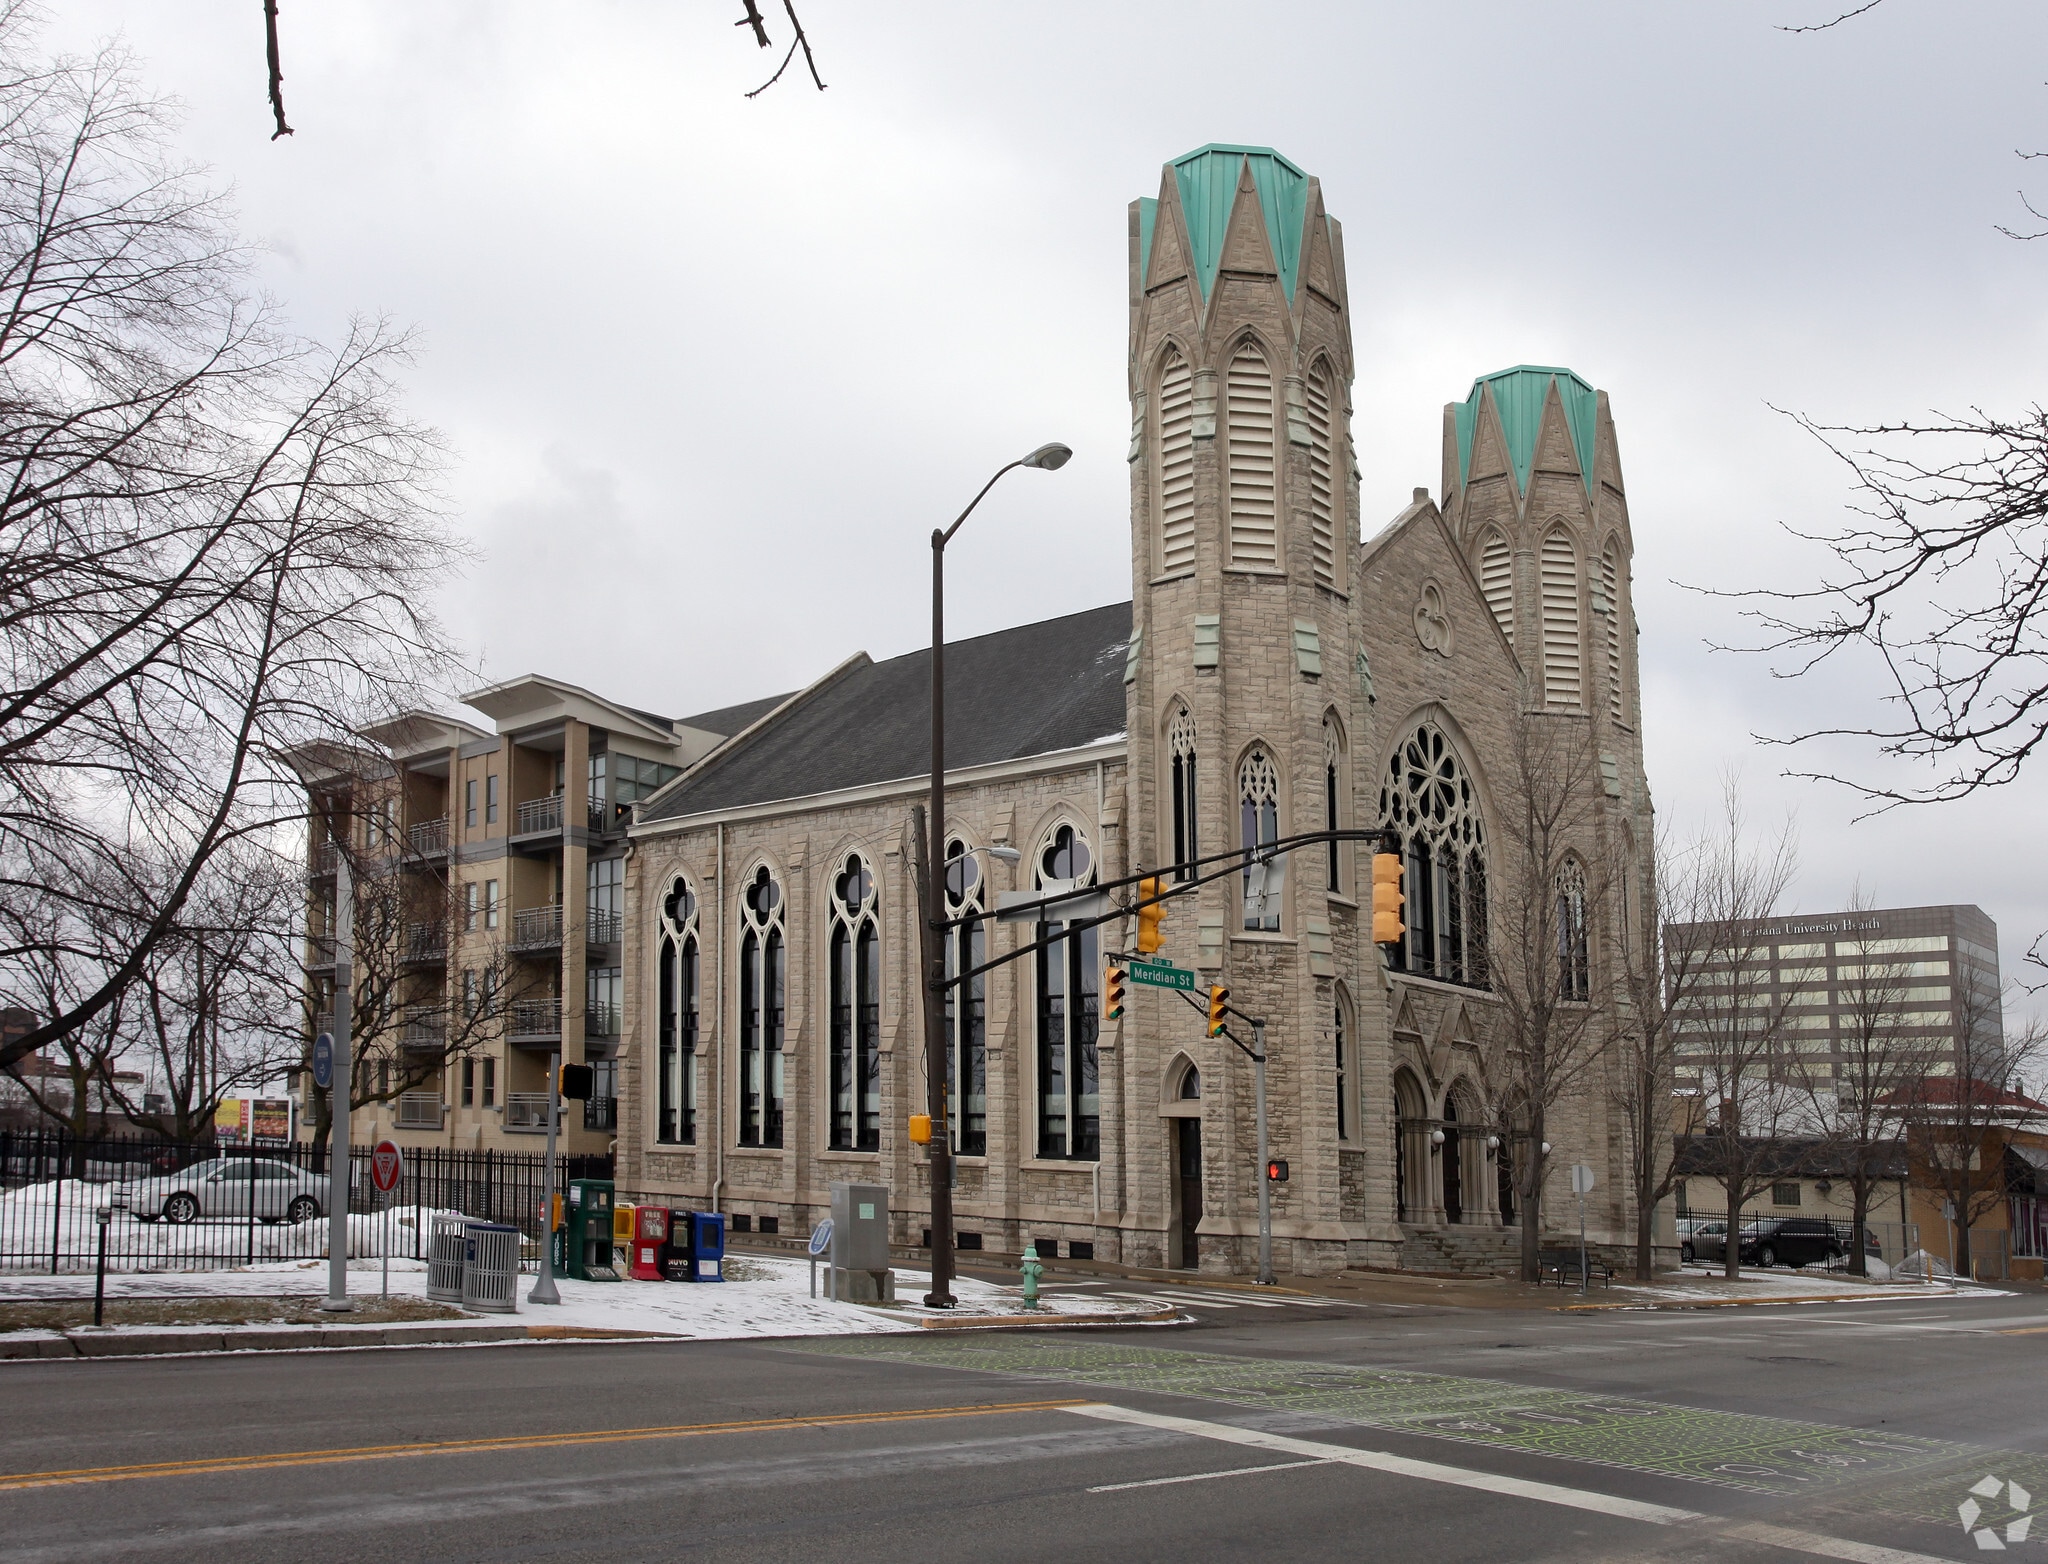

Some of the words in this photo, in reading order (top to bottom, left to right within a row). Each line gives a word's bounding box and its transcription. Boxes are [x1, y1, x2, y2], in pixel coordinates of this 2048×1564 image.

[1784, 921, 1839, 936] University
[1134, 967, 1176, 984] Meridian
[1179, 974, 1190, 986] St
